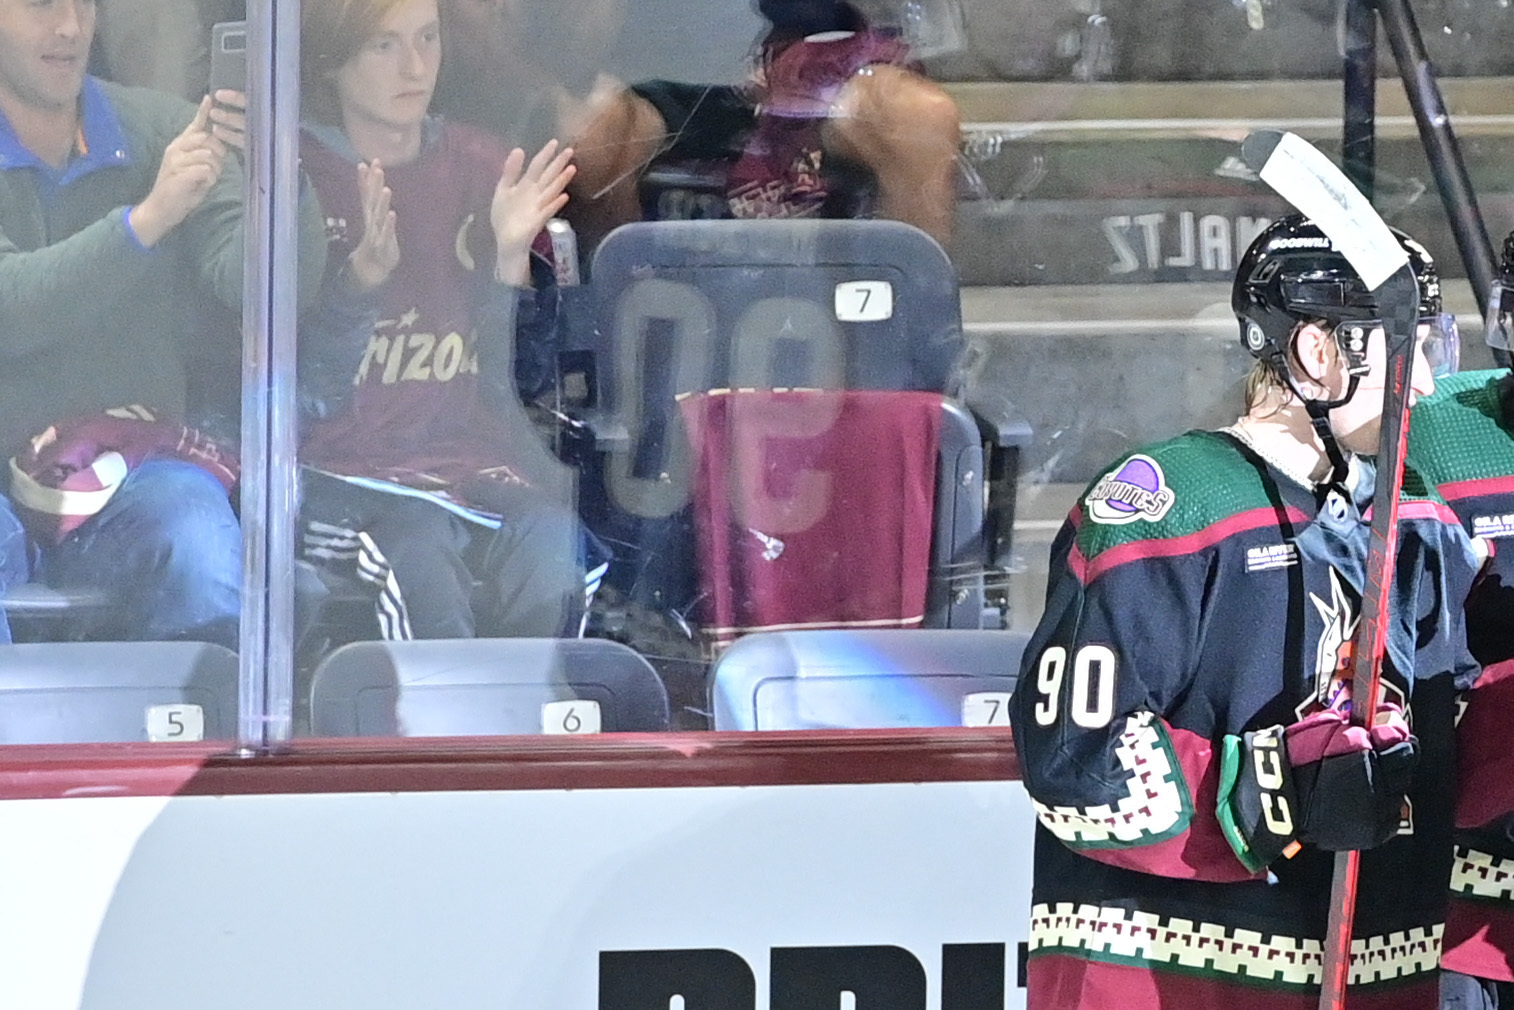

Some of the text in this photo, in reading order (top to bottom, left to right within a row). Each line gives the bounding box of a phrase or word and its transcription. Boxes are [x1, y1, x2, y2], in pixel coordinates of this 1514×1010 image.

[854, 289, 872, 314] 7
[1034, 644, 1117, 729] 90
[166, 711, 184, 738] 5
[562, 707, 582, 734] 6
[983, 700, 1001, 725] 7
[1251, 726, 1296, 837] CCM
